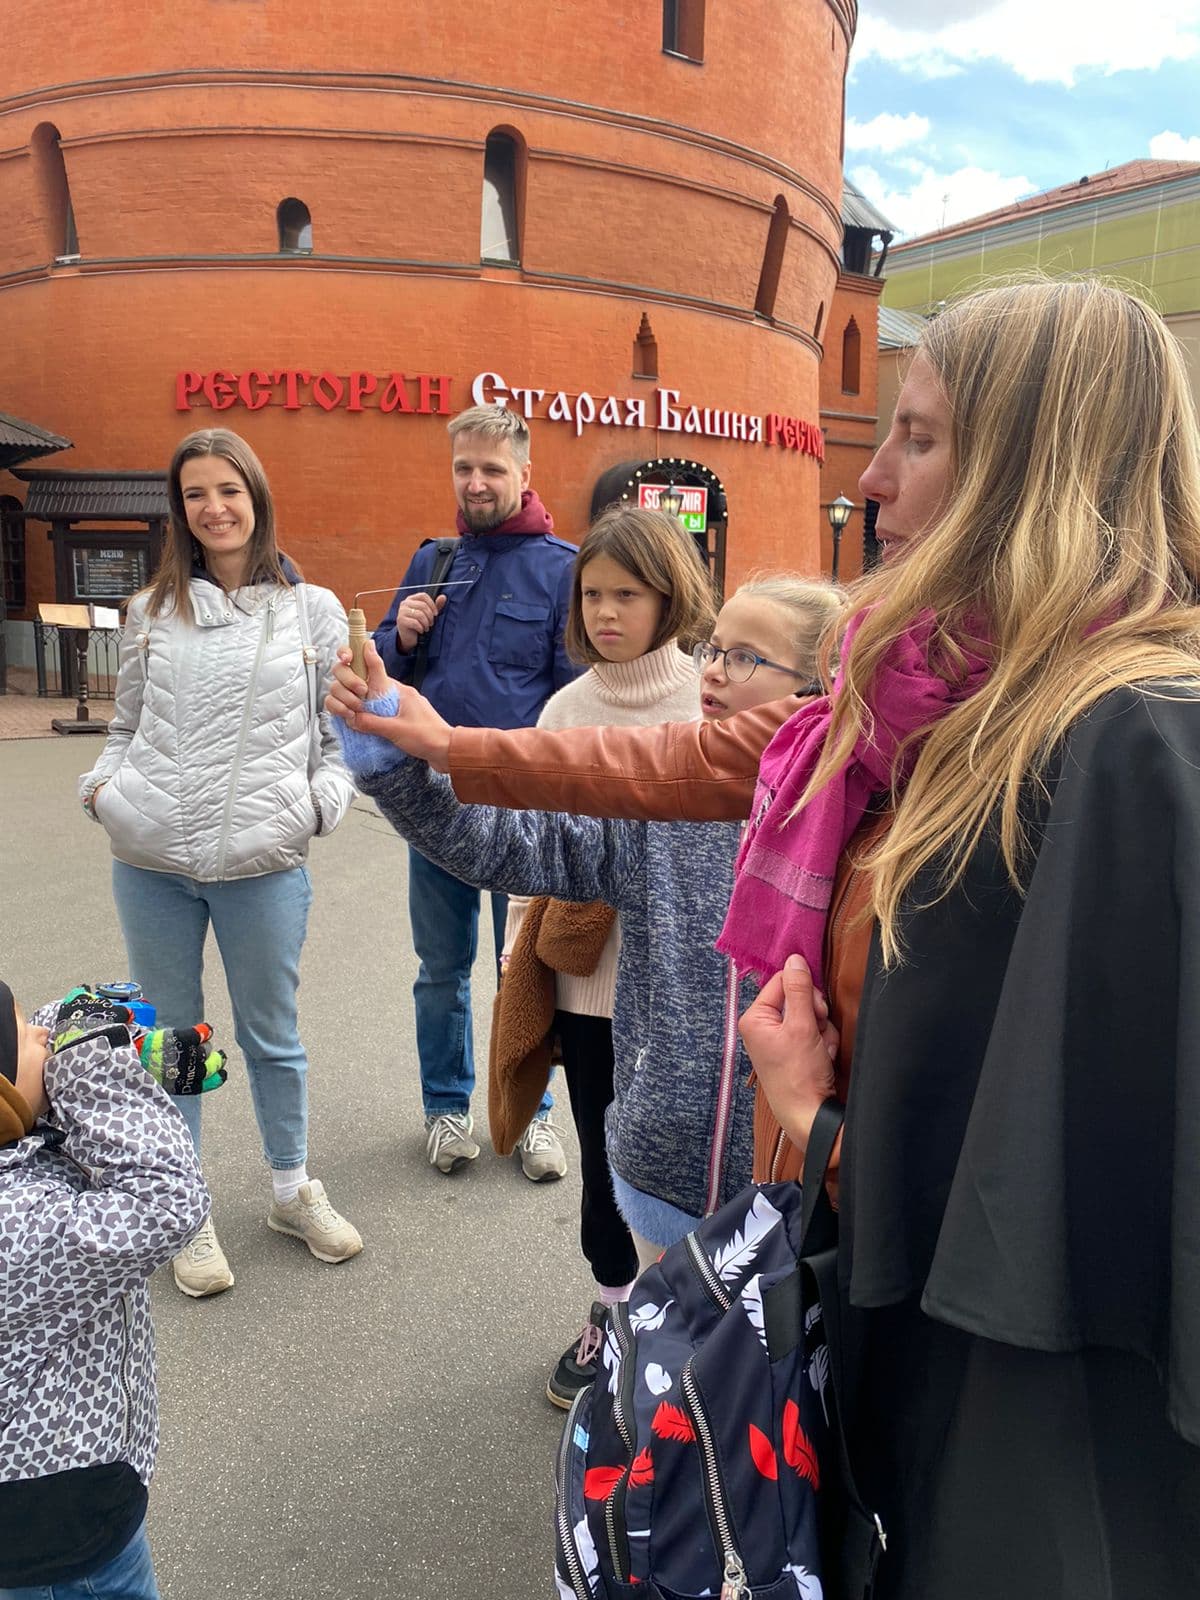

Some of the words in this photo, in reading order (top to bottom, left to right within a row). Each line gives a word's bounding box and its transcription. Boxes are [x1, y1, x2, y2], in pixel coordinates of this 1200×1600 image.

[175, 370, 452, 415] РЕСТОРАН
[472, 372, 645, 436] Старая
[656, 387, 762, 442] Башня
[644, 488, 702, 512] SONIR
